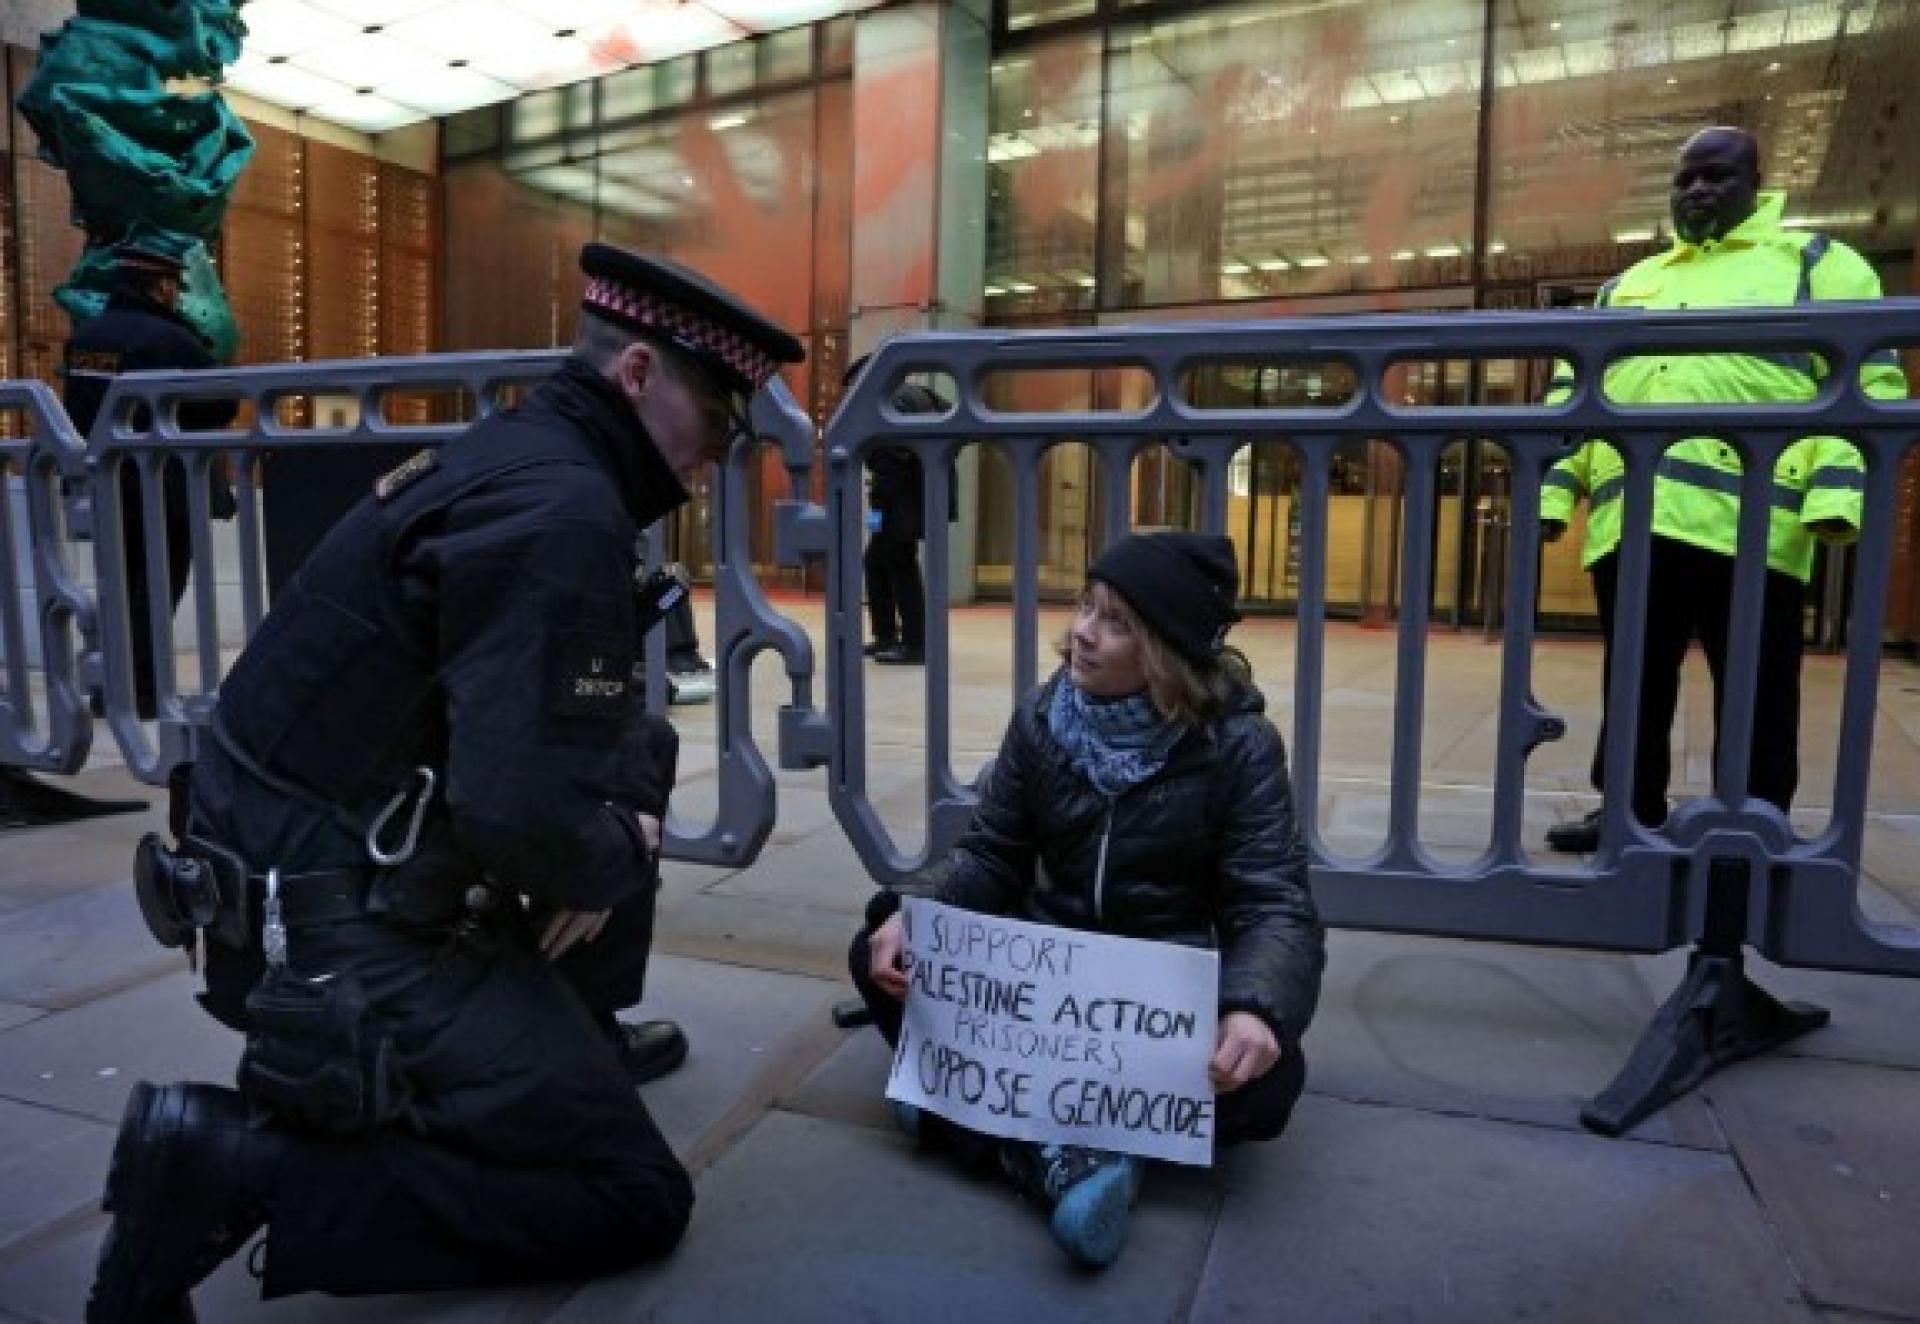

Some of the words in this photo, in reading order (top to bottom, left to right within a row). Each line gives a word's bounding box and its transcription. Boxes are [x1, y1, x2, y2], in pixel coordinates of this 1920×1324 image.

[931, 914, 1085, 976] SUPPORT
[904, 951, 1035, 1022] PALESTINE
[1052, 994, 1195, 1039] ACTION
[956, 1011, 1122, 1073] PRISONERS
[918, 1037, 1034, 1119] OPPOSE
[1048, 1077, 1215, 1138] GENOCIDE
